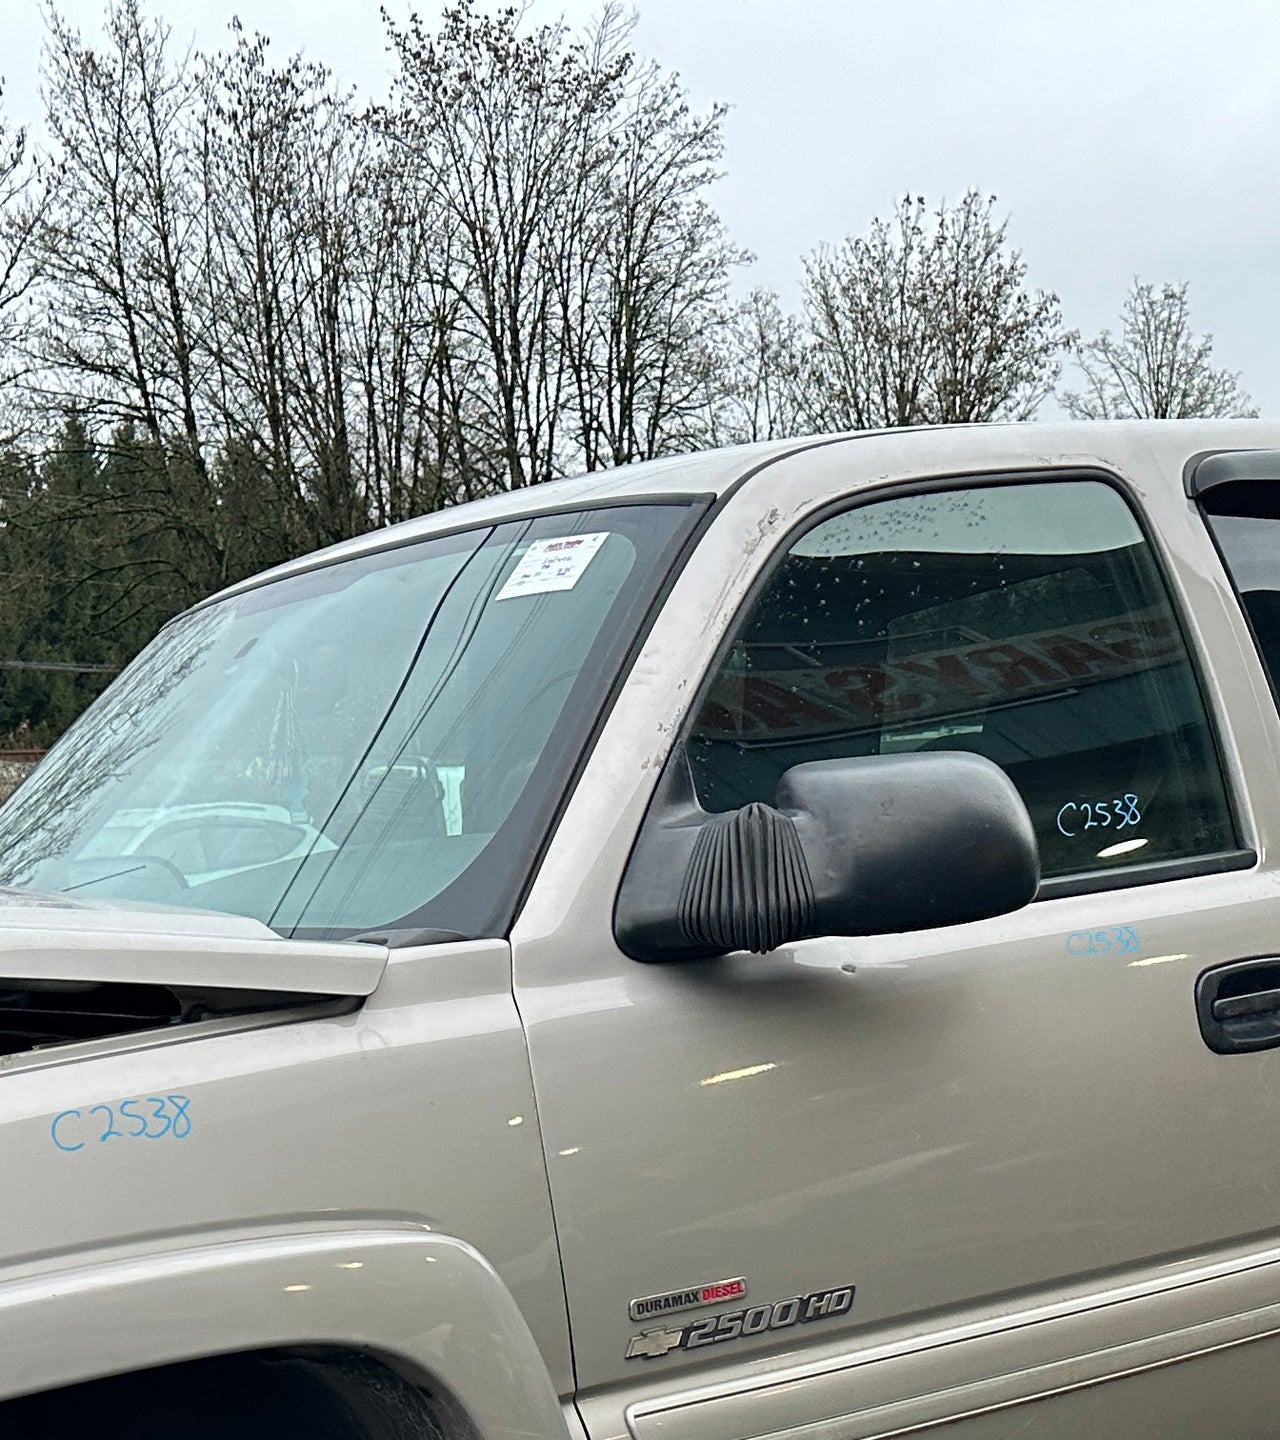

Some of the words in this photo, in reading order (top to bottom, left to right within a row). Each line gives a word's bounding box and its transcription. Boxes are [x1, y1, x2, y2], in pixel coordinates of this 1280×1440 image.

[1056, 793, 1141, 837] C2538
[49, 1094, 193, 1151] C2538
[636, 1289, 700, 1316] DURAMAX
[701, 1281, 745, 1302] DIESEL
